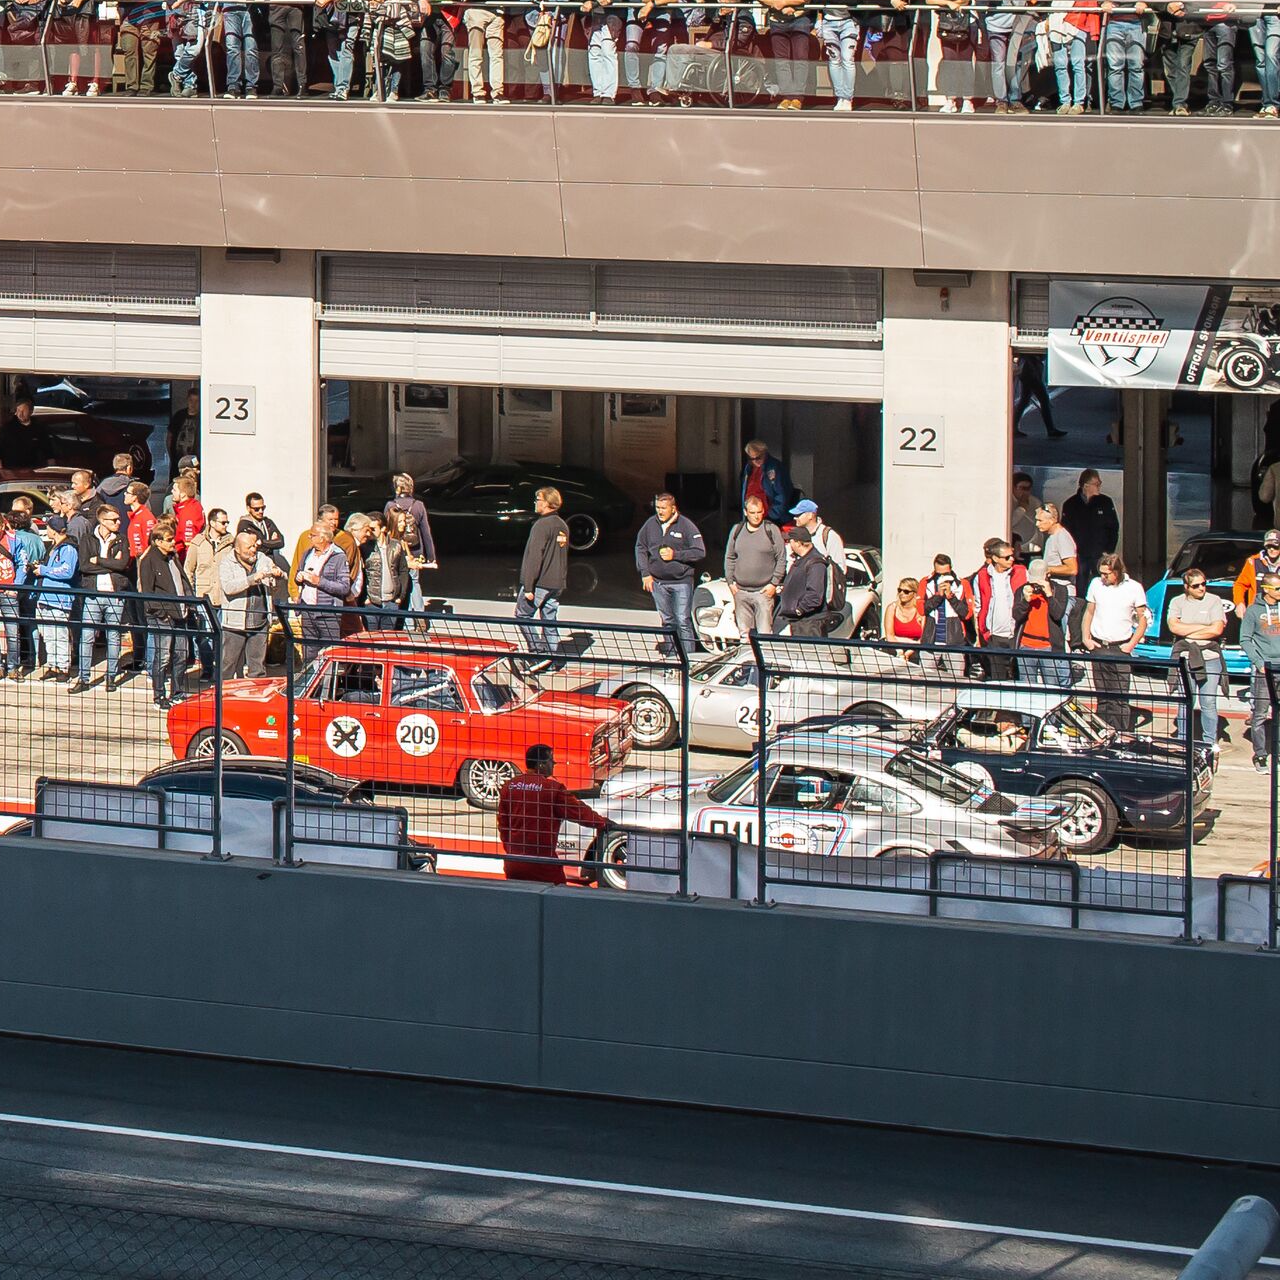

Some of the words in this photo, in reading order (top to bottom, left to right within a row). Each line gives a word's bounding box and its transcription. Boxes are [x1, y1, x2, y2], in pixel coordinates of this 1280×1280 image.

[1085, 329, 1167, 346] Ventilspiel
[215, 397, 249, 421] 23
[899, 427, 937, 452] 22
[400, 724, 437, 745] 209
[770, 836, 806, 845] MARTINI
